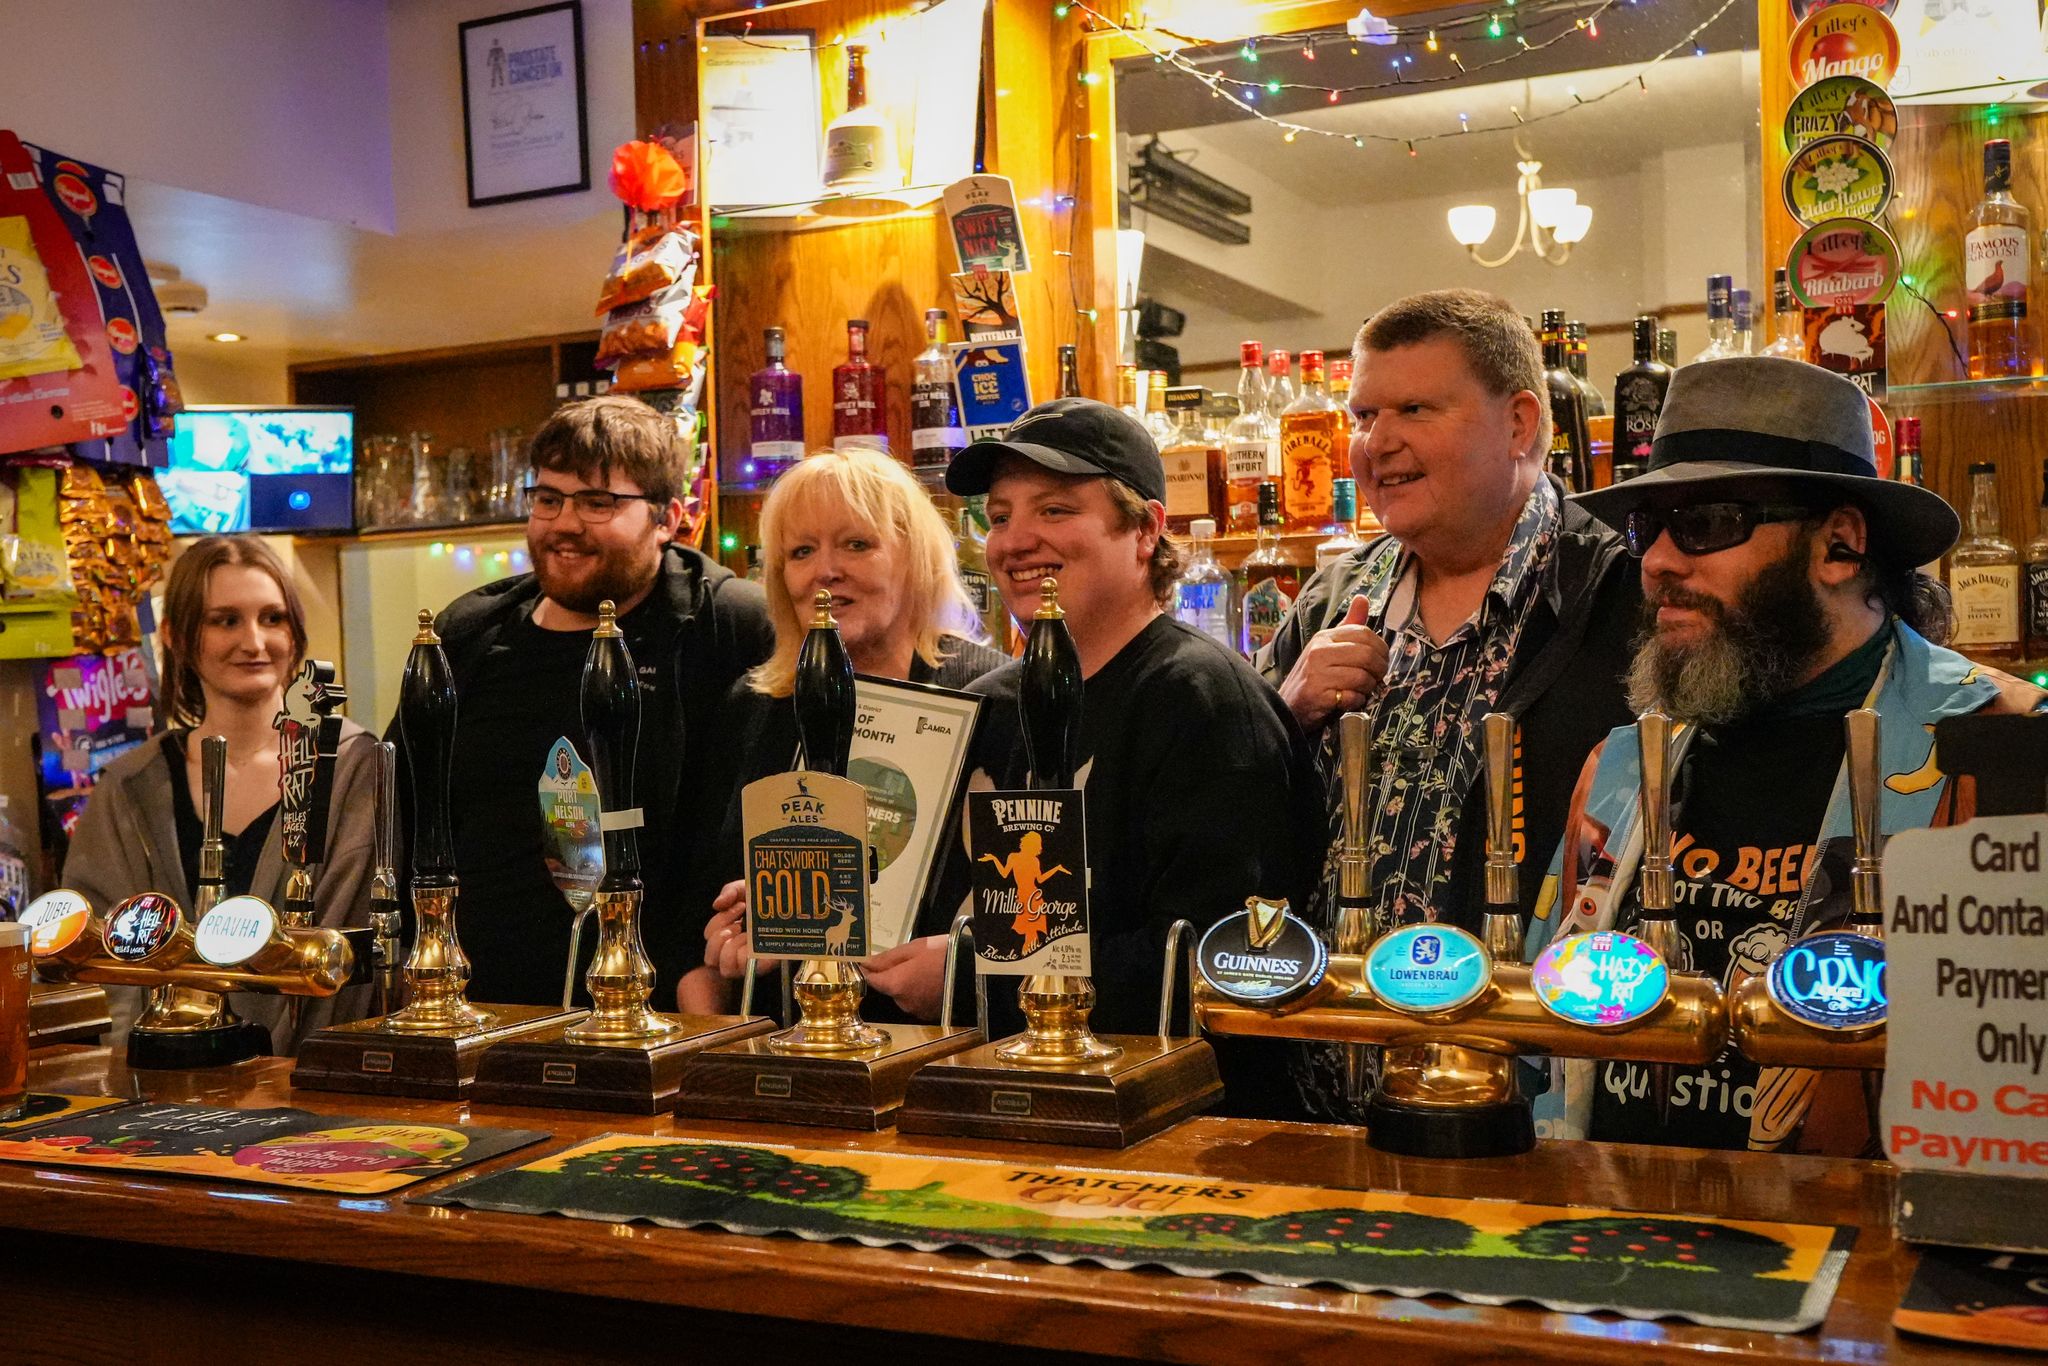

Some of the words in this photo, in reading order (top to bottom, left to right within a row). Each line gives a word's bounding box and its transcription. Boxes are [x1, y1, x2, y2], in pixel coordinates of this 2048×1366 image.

[1812, 15, 1868, 38] Lilley's
[1802, 53, 1885, 82] Mango
[1798, 87, 1849, 113] Lilley's
[1791, 112, 1842, 135] CRAZY
[964, 190, 991, 200] PEAK
[1800, 182, 1887, 221] Elderflower
[1845, 202, 1877, 218] Cider
[956, 215, 998, 238] SWIFT
[963, 236, 999, 258] NICK
[1806, 230, 1871, 256] Lilley's
[1970, 237, 2020, 253] FAMOUS
[1970, 247, 2019, 262] GROUSE
[1803, 272, 1884, 298] Rhubarb
[971, 372, 998, 382] CHOC
[973, 381, 999, 394] ICE
[1957, 574, 1980, 593] JACK
[1978, 573, 2011, 589] DANIEL'S
[857, 713, 875, 726] OF
[921, 722, 952, 736] CAMRA
[852, 726, 896, 745] MONTH
[278, 733, 318, 769] HELL
[280, 767, 313, 810] RAT
[557, 789, 580, 804] PORT
[283, 811, 307, 824] HELLES
[554, 804, 585, 820] NELSON
[781, 800, 825, 815] PEAK
[990, 799, 1063, 826] PENNINE
[283, 821, 308, 834] LAGER
[790, 814, 820, 824] ALES
[1002, 823, 1043, 833] BREWING
[287, 835, 301, 848] 4%
[1971, 831, 2041, 873] Card
[755, 850, 830, 870] CHATSWORTH
[756, 870, 831, 921] GOLD
[982, 888, 1024, 915] Millie
[1027, 888, 1078, 922] George
[1711, 882, 1763, 909] TWO
[37, 901, 71, 926] JUBEL
[140, 908, 161, 931] HELL
[1891, 894, 1949, 935] And
[205, 914, 260, 939] PRAVHA
[757, 926, 784, 934] BREWED
[1044, 920, 1085, 944] attitude
[1695, 920, 1724, 940] OR
[981, 944, 1019, 962] Blonde
[1213, 952, 1303, 976] GUINNESS
[1597, 955, 1650, 992] HAZY
[1976, 1022, 2047, 1076] Only
[1911, 1079, 1979, 1114] No
[138, 1106, 290, 1127] Lilley's
[118, 1120, 226, 1137] Cider
[353, 1126, 441, 1140] Lilley's
[262, 1145, 391, 1168] Raspberry
[265, 1157, 340, 1172] Mojito
[1006, 1170, 1254, 1200] THATCHERS
[1018, 1185, 1186, 1212] Gold
